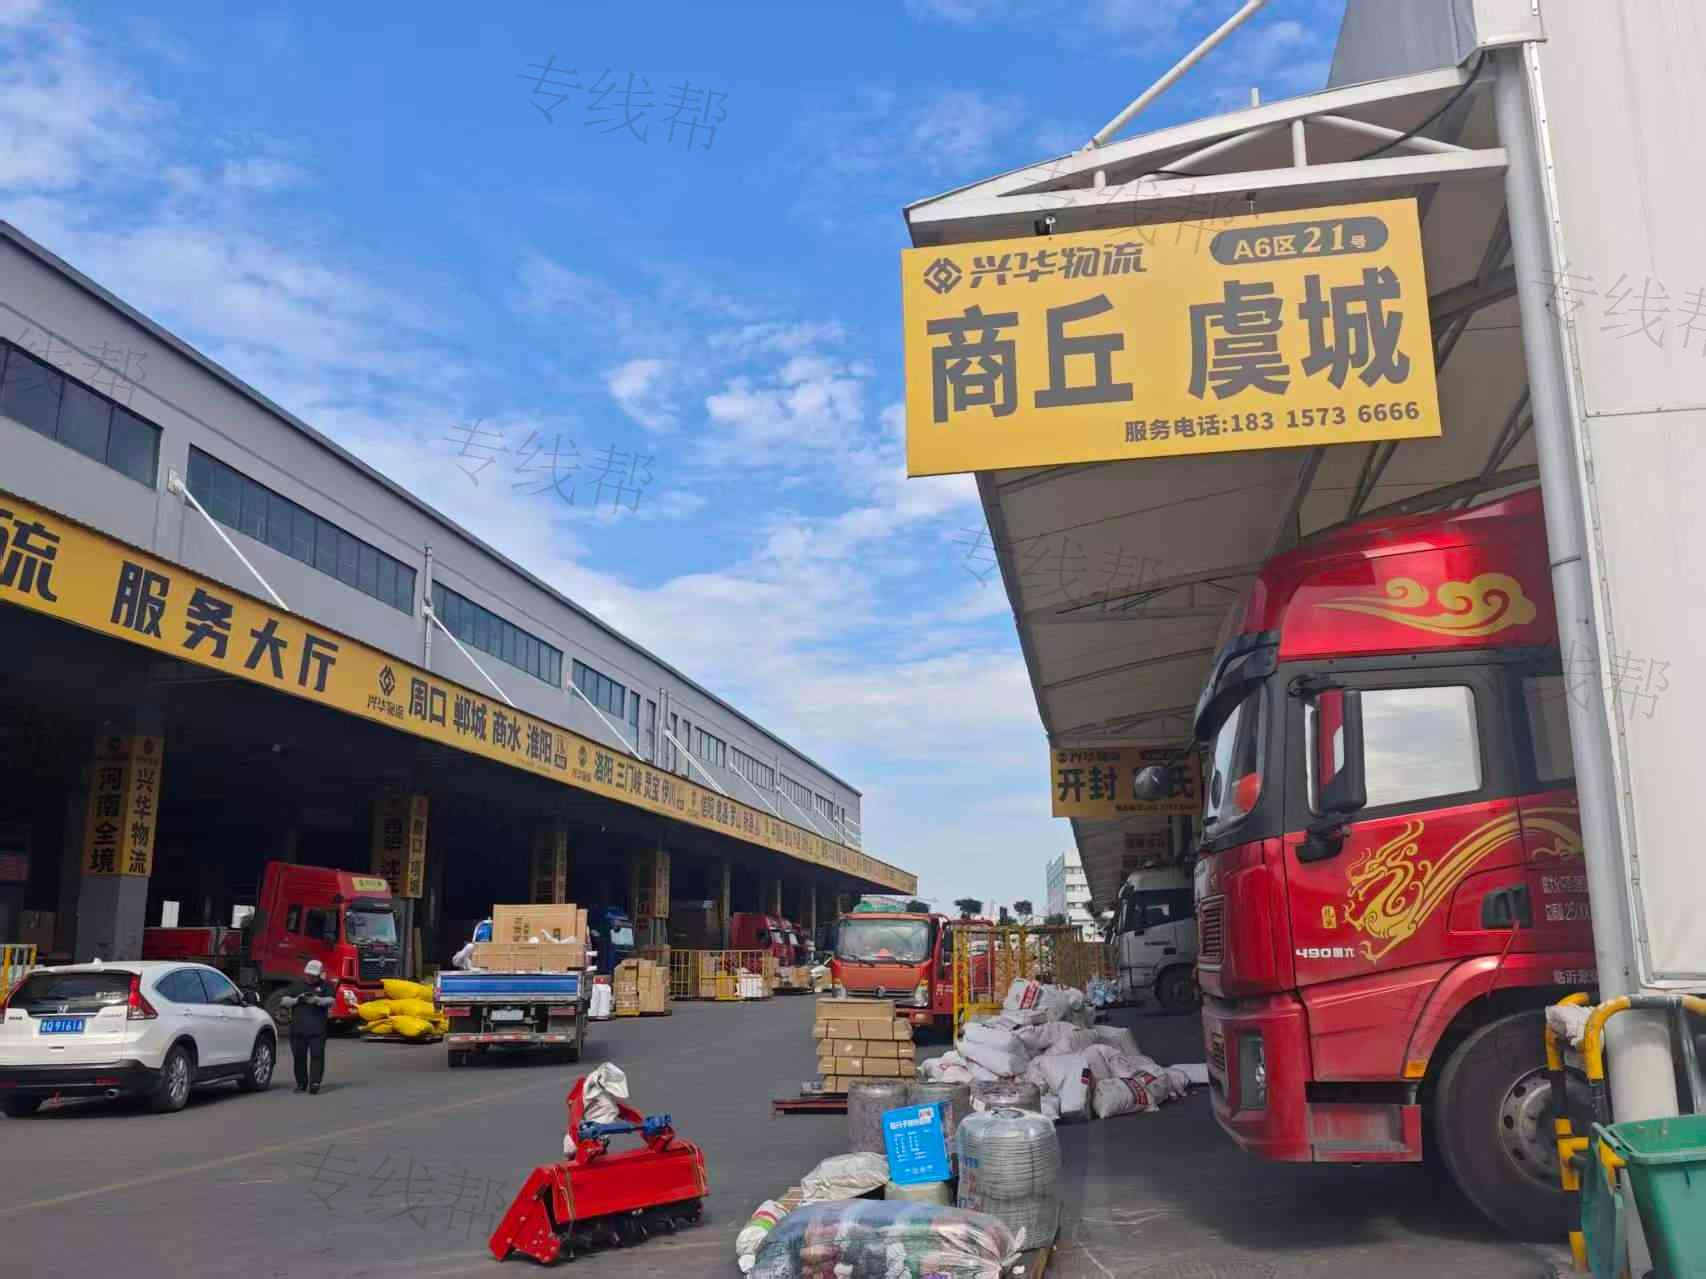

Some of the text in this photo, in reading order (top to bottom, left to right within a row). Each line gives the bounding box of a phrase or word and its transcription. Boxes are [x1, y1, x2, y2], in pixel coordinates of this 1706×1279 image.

[969, 242, 1147, 289] 兴华物流
[926, 266, 1411, 424] 商丘 虞城
[1286, 406, 1347, 430] 1573
[1358, 401, 1421, 423] 6666
[110, 559, 339, 693] 服务大厅
[409, 676, 447, 727] 周口
[492, 710, 521, 752] 商水
[128, 768, 155, 874] 兴华物流
[1057, 767, 1118, 802] 开封
